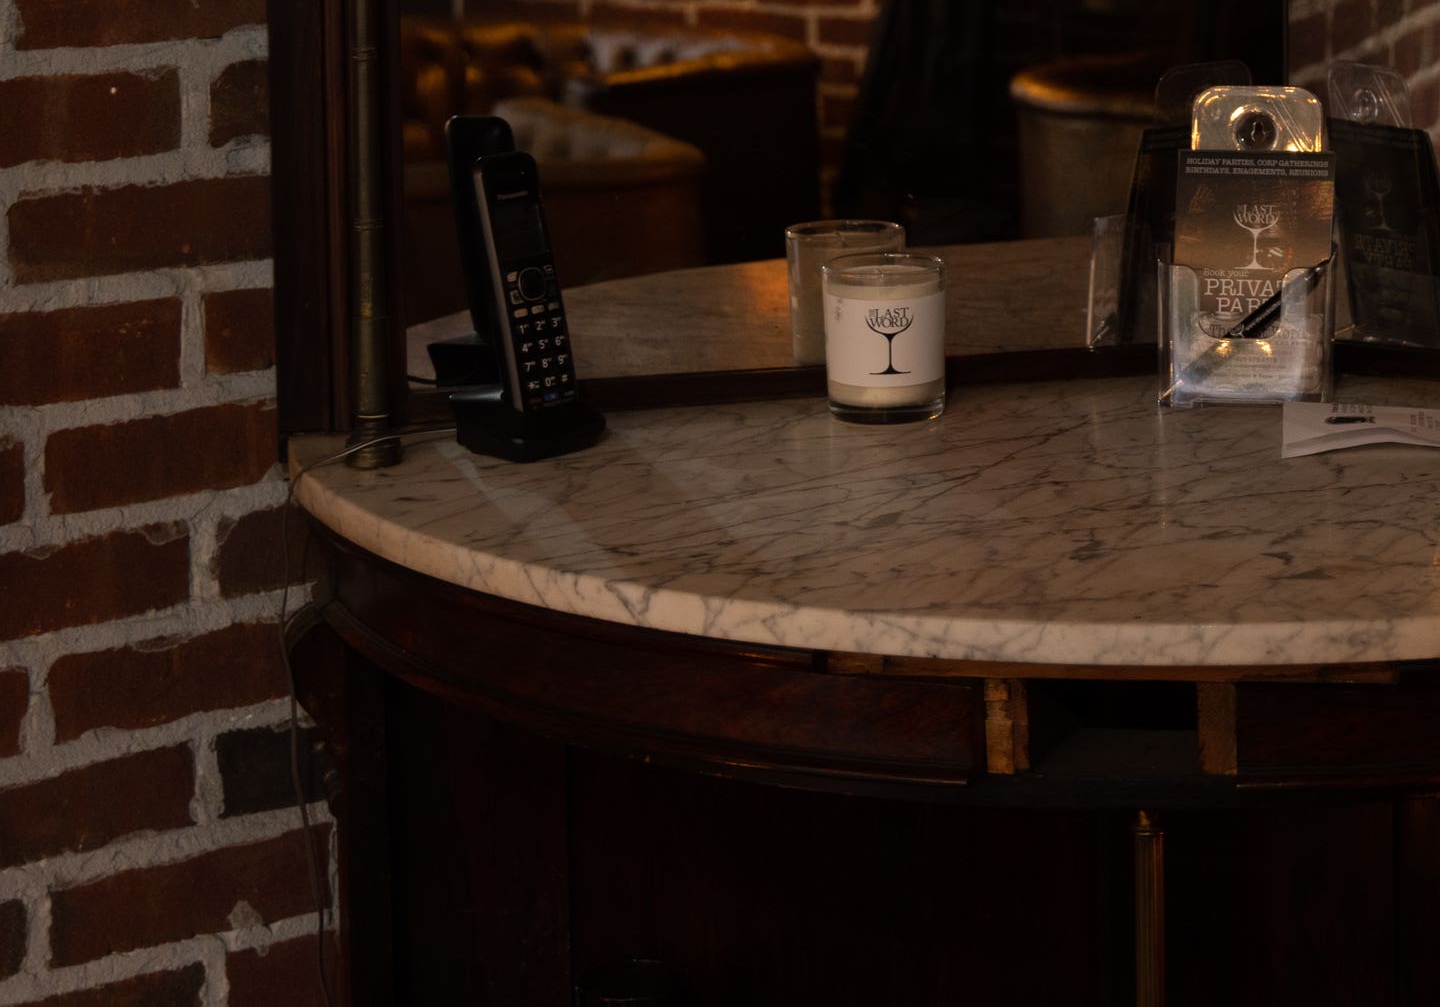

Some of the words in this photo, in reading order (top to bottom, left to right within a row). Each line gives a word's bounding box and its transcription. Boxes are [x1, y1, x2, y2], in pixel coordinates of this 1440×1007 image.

[1187, 158, 1220, 166] HOLIDAY
[1279, 160, 1329, 168] GATHERINGS
[1289, 169, 1329, 177] REUNIONS
[1243, 204, 1276, 215] LAST
[1238, 214, 1275, 224] WORD
[1203, 268, 1226, 276] Book
[1227, 269, 1249, 278] your
[1204, 278, 1283, 297] PRIVA
[1216, 297, 1270, 314] PAR
[875, 307, 910, 318] LAST
[870, 317, 910, 328] WORD
